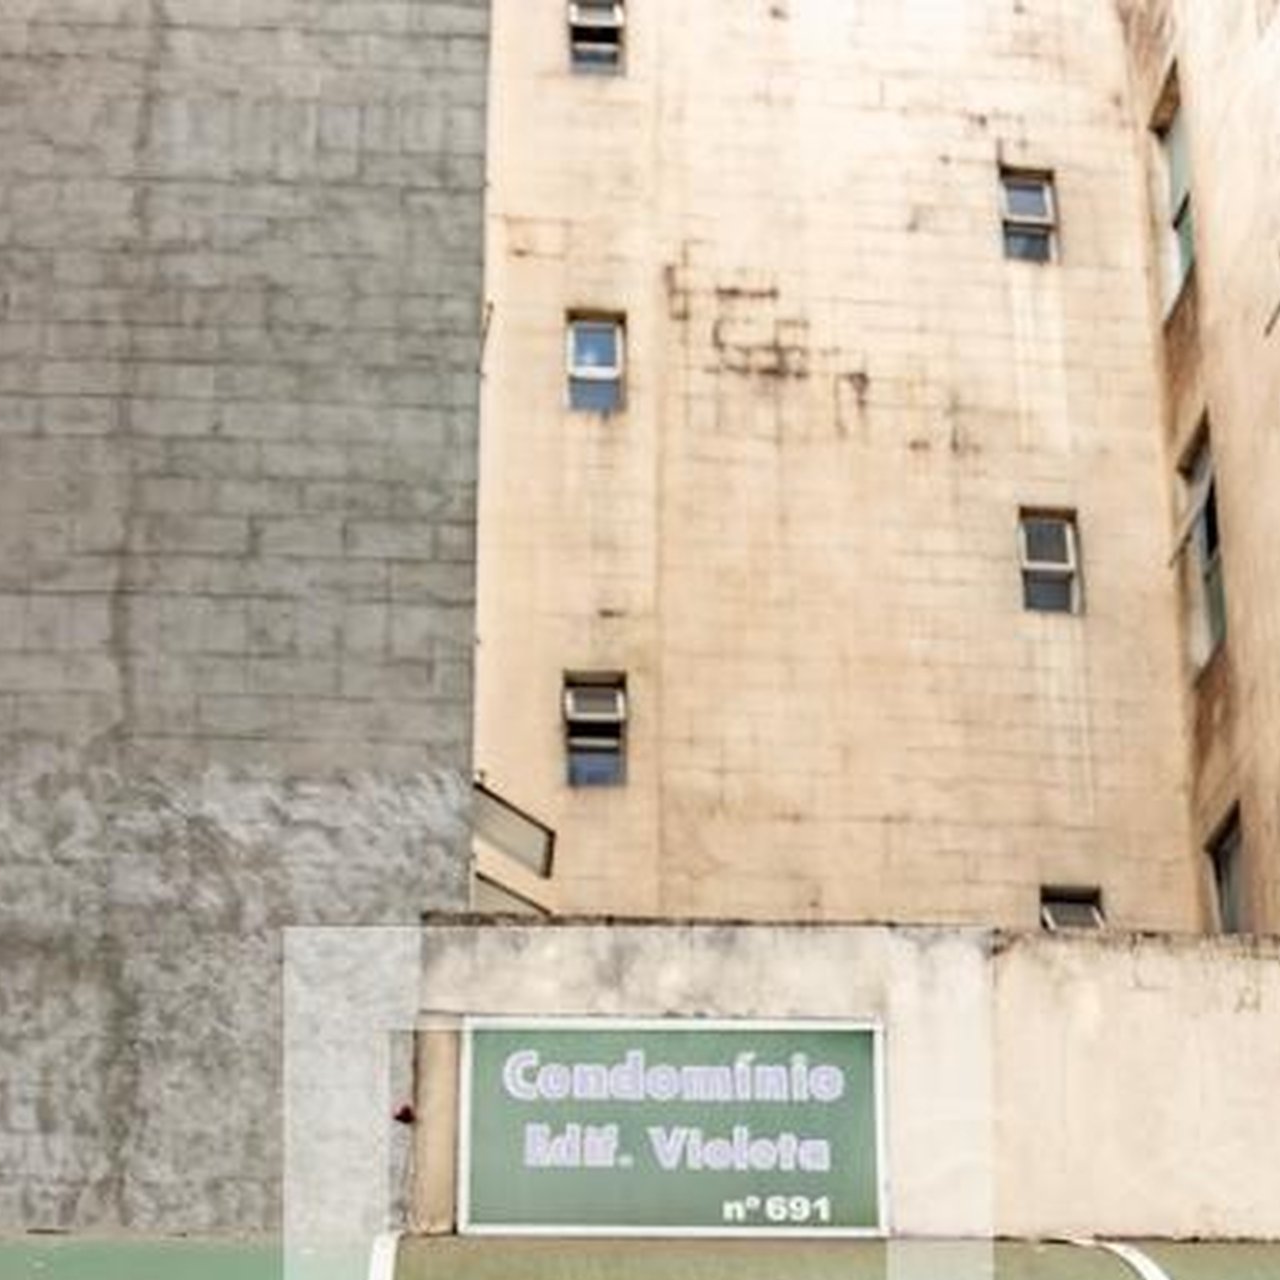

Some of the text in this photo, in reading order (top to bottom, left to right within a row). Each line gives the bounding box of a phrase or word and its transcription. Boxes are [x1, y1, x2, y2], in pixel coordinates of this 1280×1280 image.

[503, 1049, 845, 1101] Condomínio
[524, 1122, 830, 1171] Edif. Violeta
[765, 1195, 830, 1221] 691
